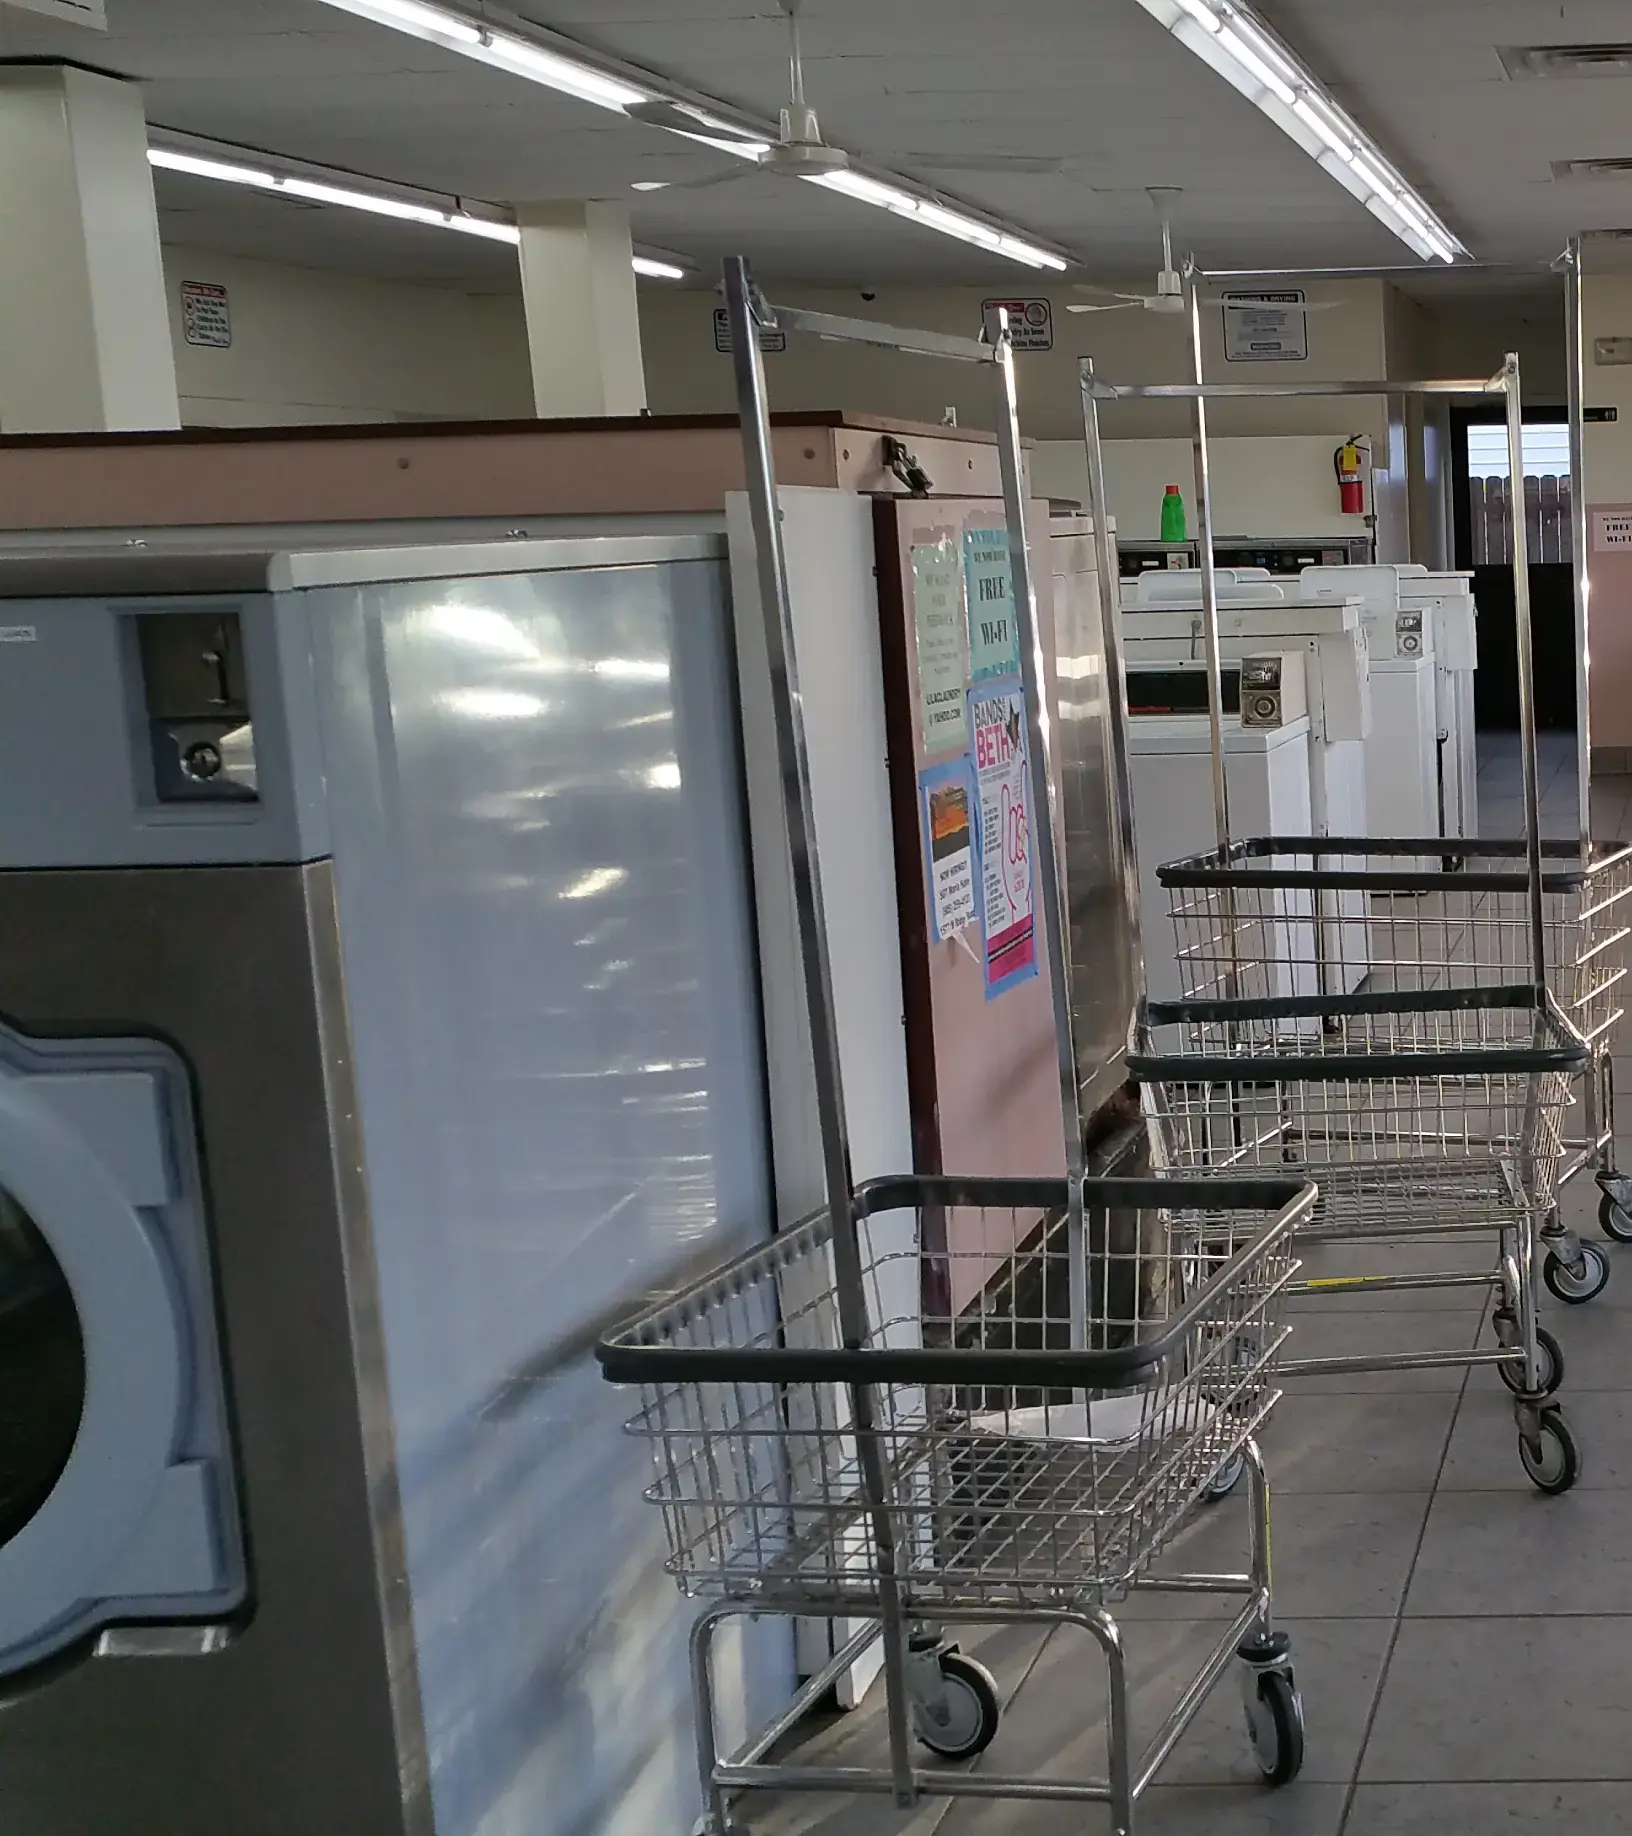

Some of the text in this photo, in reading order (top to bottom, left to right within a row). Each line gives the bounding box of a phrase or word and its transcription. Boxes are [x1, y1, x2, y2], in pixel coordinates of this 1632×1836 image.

[1606, 535, 1632, 543] WI-FI
[978, 575, 1005, 602] FREE
[980, 619, 1008, 647] WI-FI
[974, 697, 1003, 729] BANDS
[977, 723, 1010, 769] BETH
